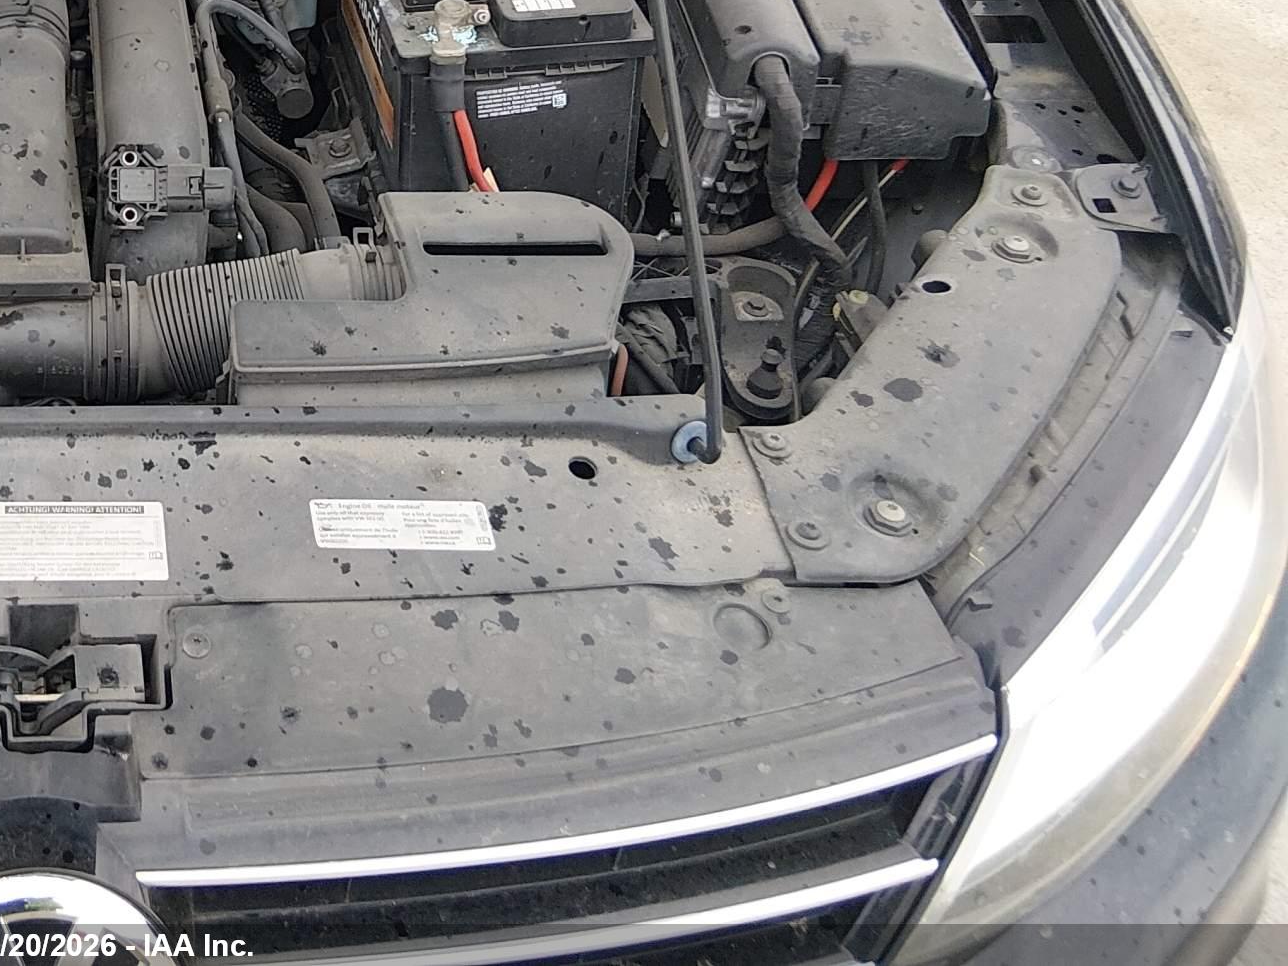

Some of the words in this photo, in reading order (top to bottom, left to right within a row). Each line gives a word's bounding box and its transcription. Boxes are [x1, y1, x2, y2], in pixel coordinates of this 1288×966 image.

[7, 506, 50, 514] ACHTUNG!
[52, 506, 94, 514] WARNING!
[95, 506, 142, 514] ATTENTION!
